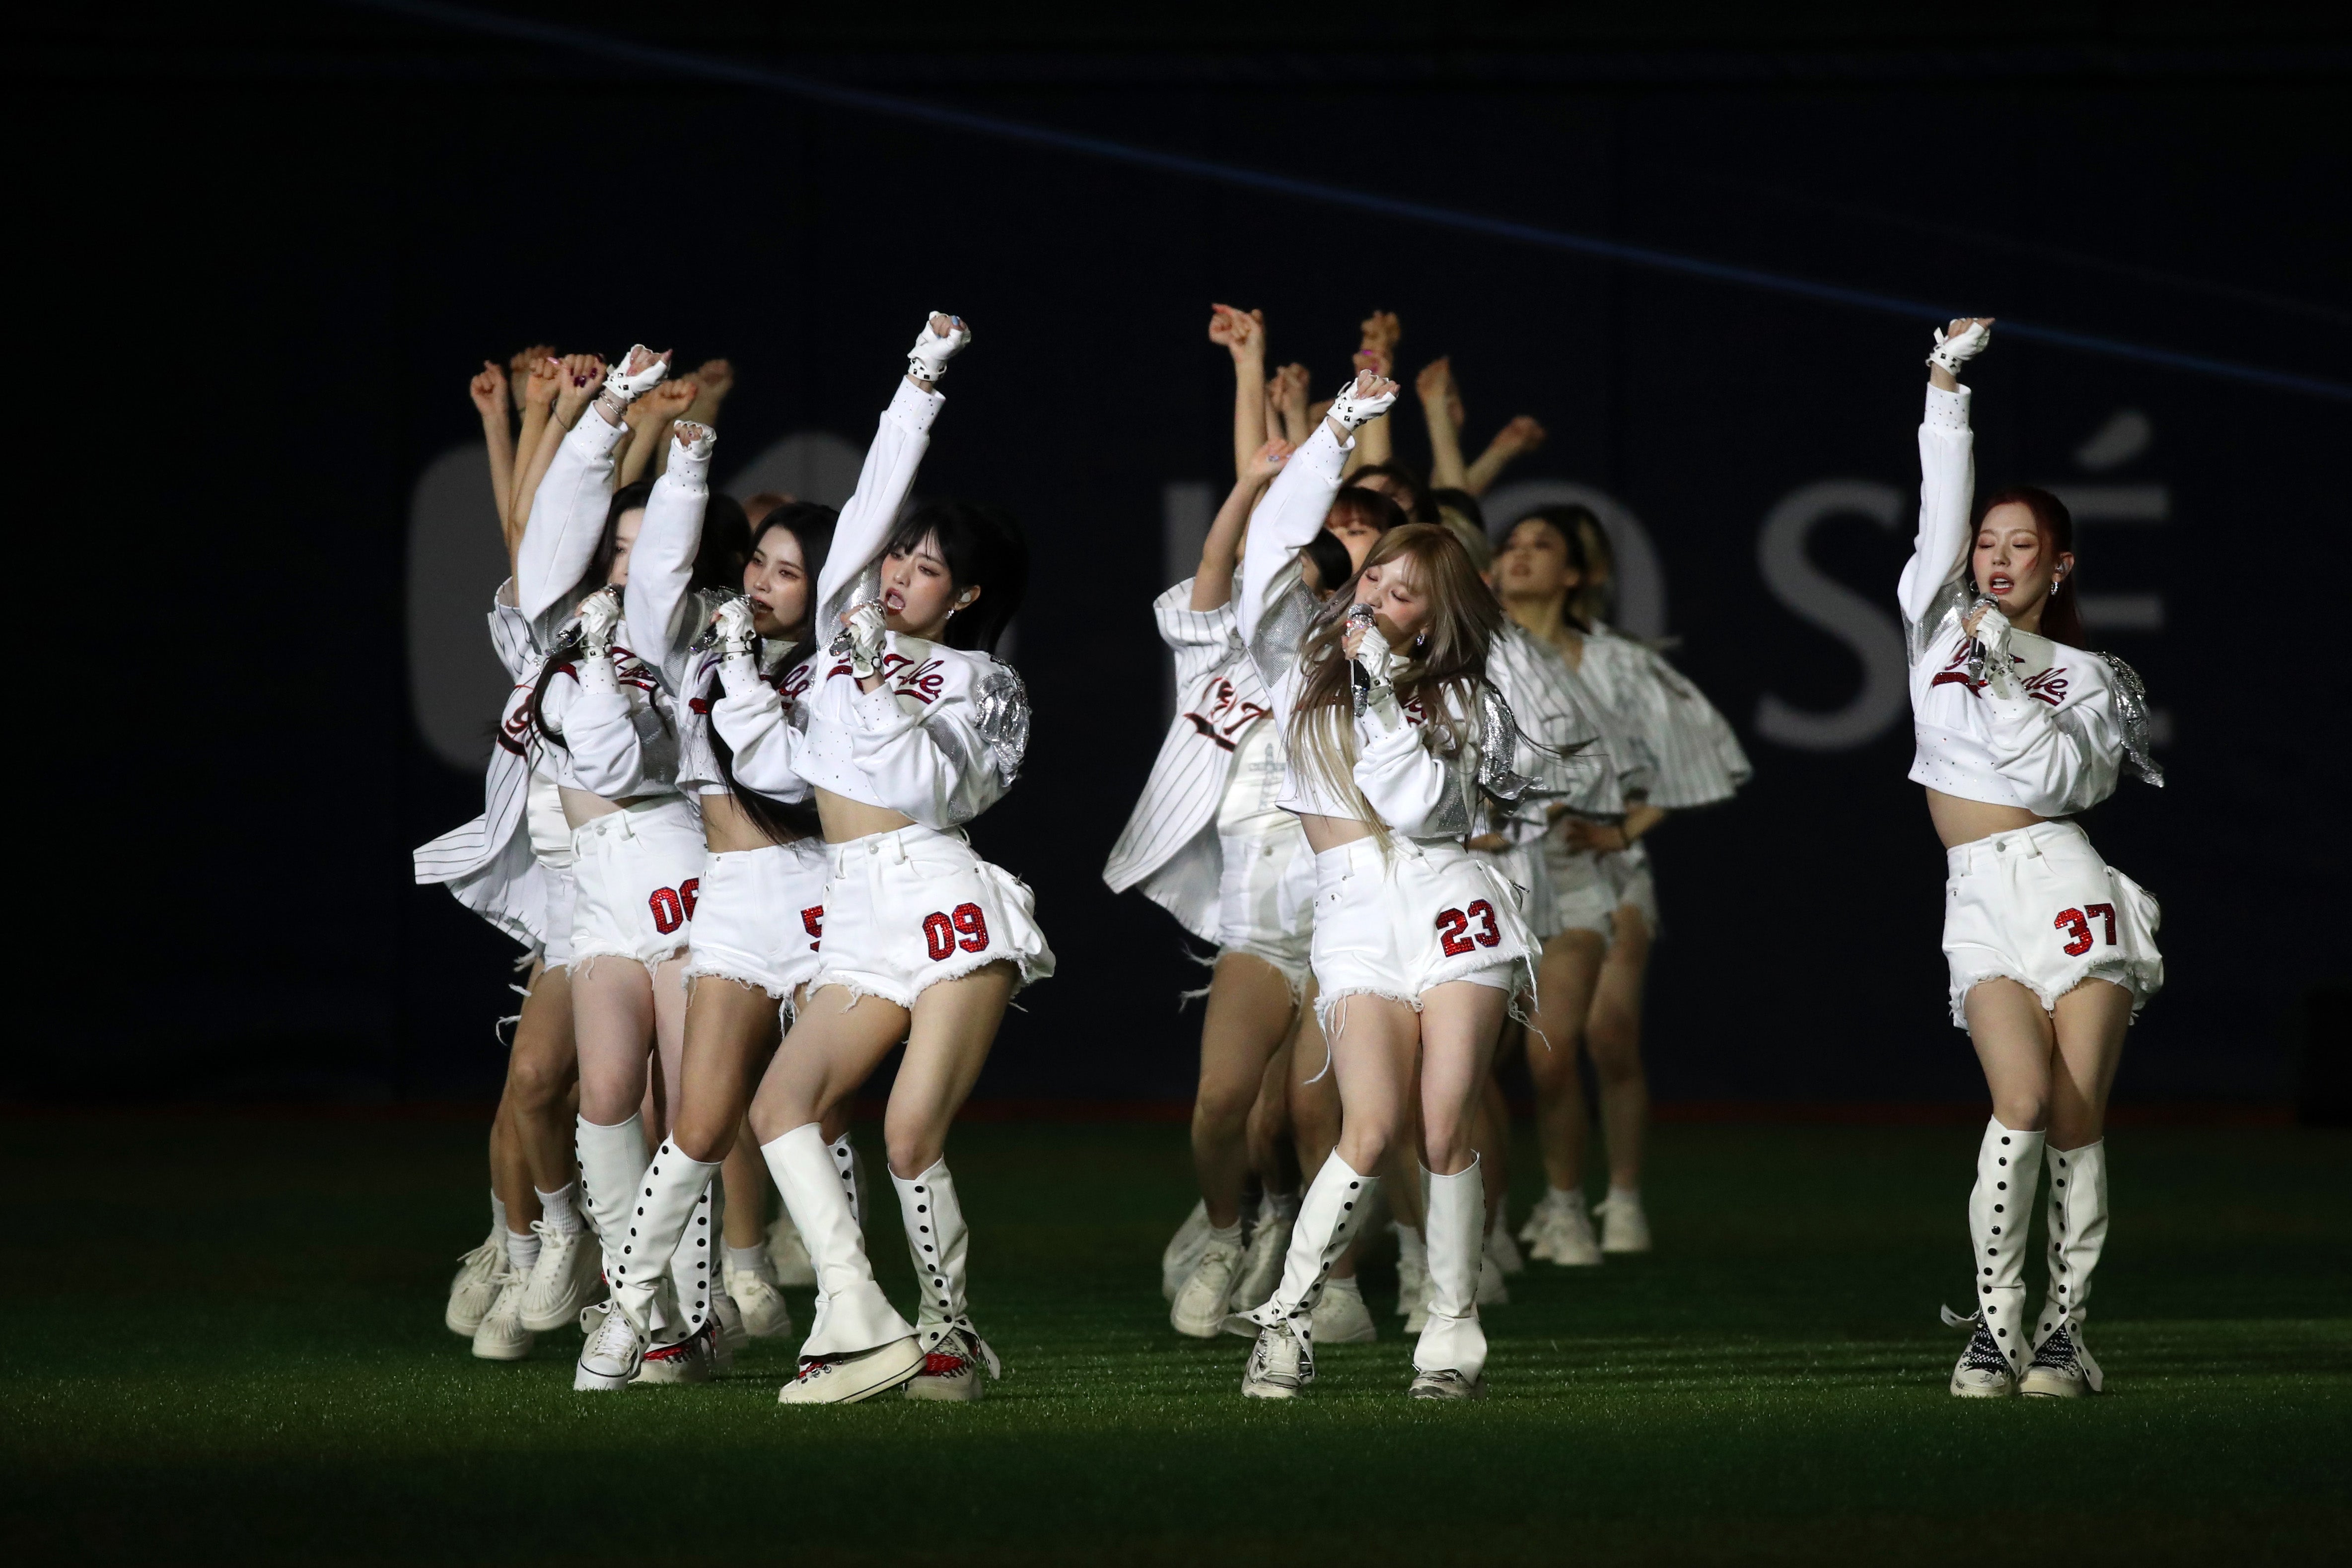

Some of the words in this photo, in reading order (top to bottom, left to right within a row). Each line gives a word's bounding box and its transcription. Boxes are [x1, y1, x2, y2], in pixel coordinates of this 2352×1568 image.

[922, 902, 990, 962] 09
[1435, 898, 1501, 958] 23
[2054, 903, 2117, 957] 37
